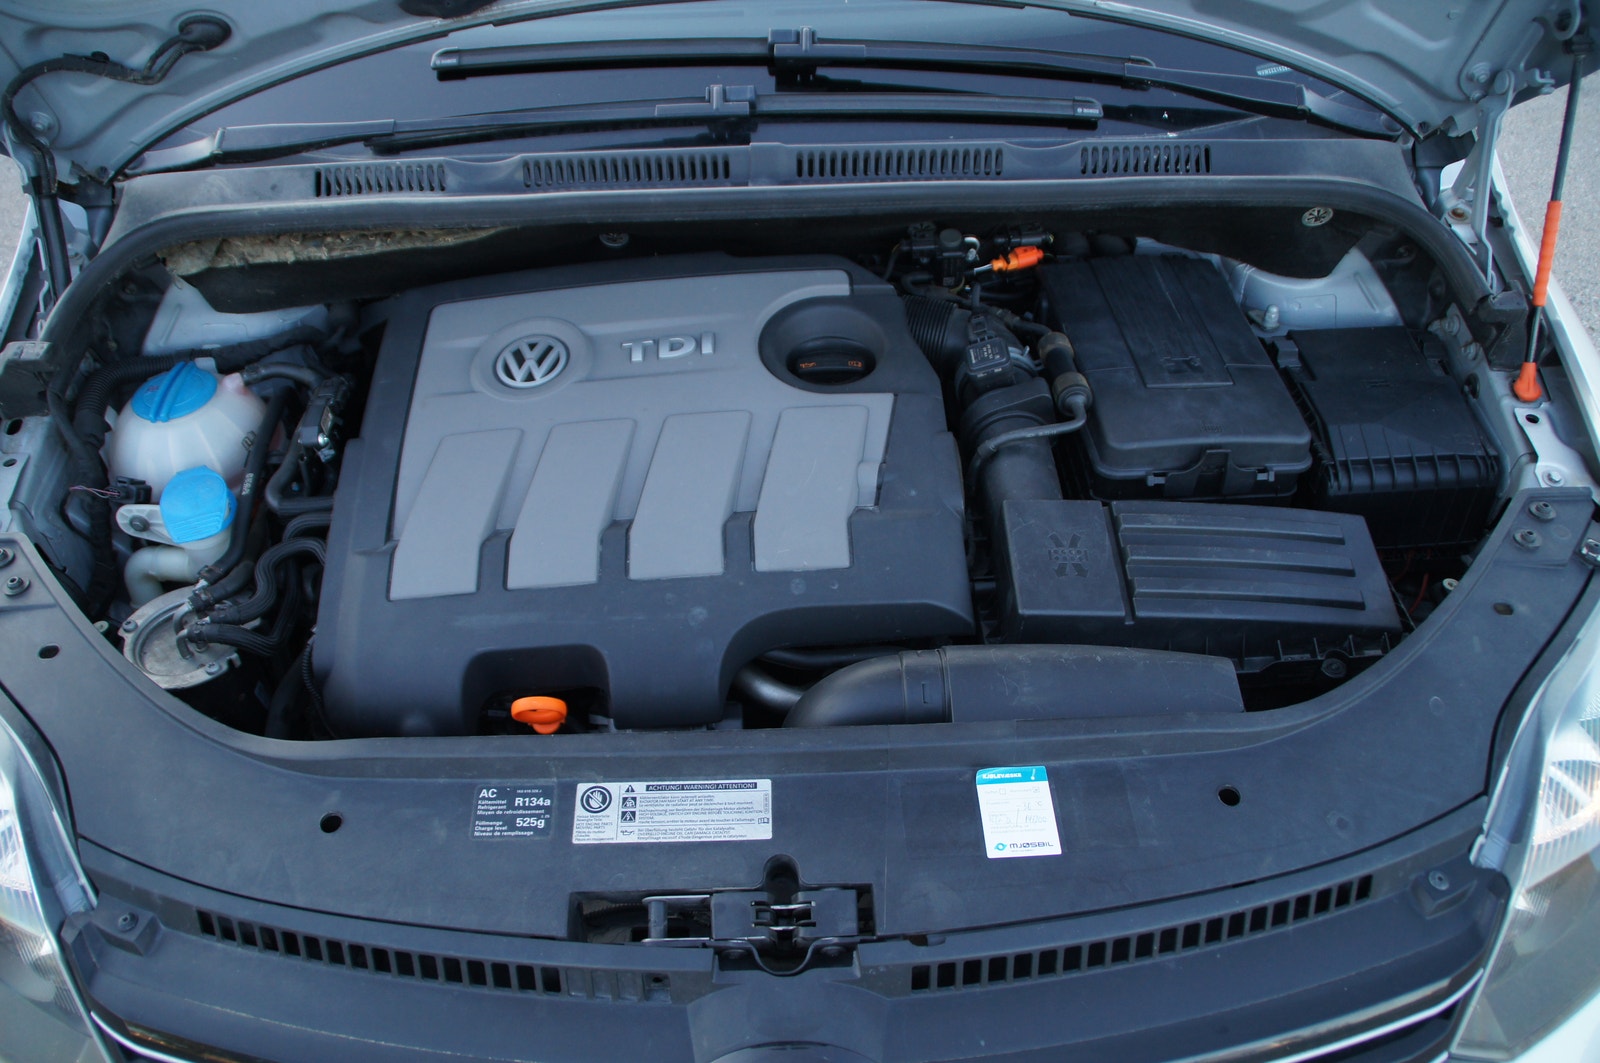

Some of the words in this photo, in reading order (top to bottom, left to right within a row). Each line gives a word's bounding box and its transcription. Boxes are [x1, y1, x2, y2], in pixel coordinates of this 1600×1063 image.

[622, 332, 714, 363] TDI
[479, 789, 497, 798] AC
[515, 797, 550, 806] R134a
[516, 818, 545, 828] 525g
